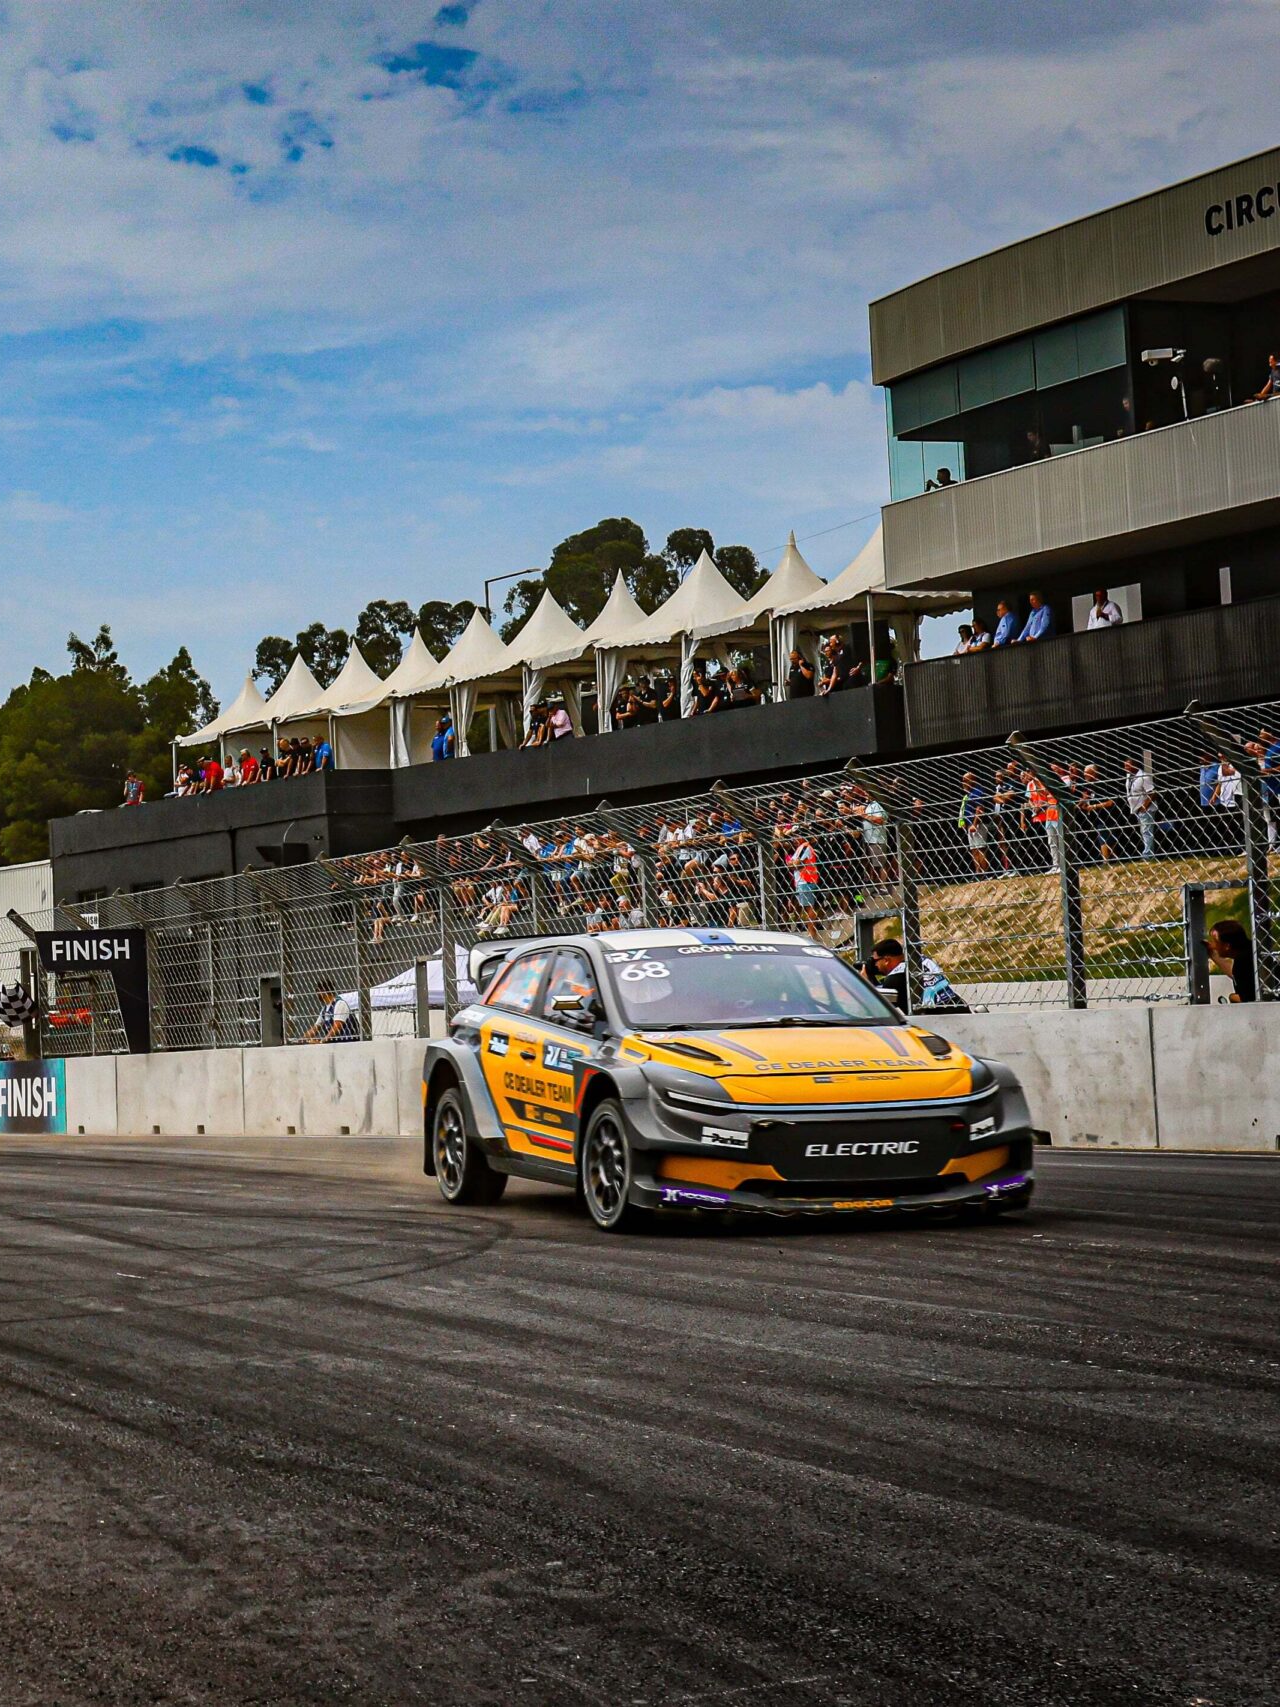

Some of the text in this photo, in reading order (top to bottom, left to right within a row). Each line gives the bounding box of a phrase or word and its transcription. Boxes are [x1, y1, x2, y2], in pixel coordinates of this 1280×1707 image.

[1205, 182, 1280, 236] CIRC
[51, 938, 130, 961] FINISH
[621, 961, 670, 981] 68
[755, 1063, 783, 1071] CE
[787, 1060, 867, 1069] DEALER
[515, 1074, 546, 1098] DEALER
[547, 1082, 573, 1104] TEAM
[805, 1141, 920, 1157] ELECTRIC
